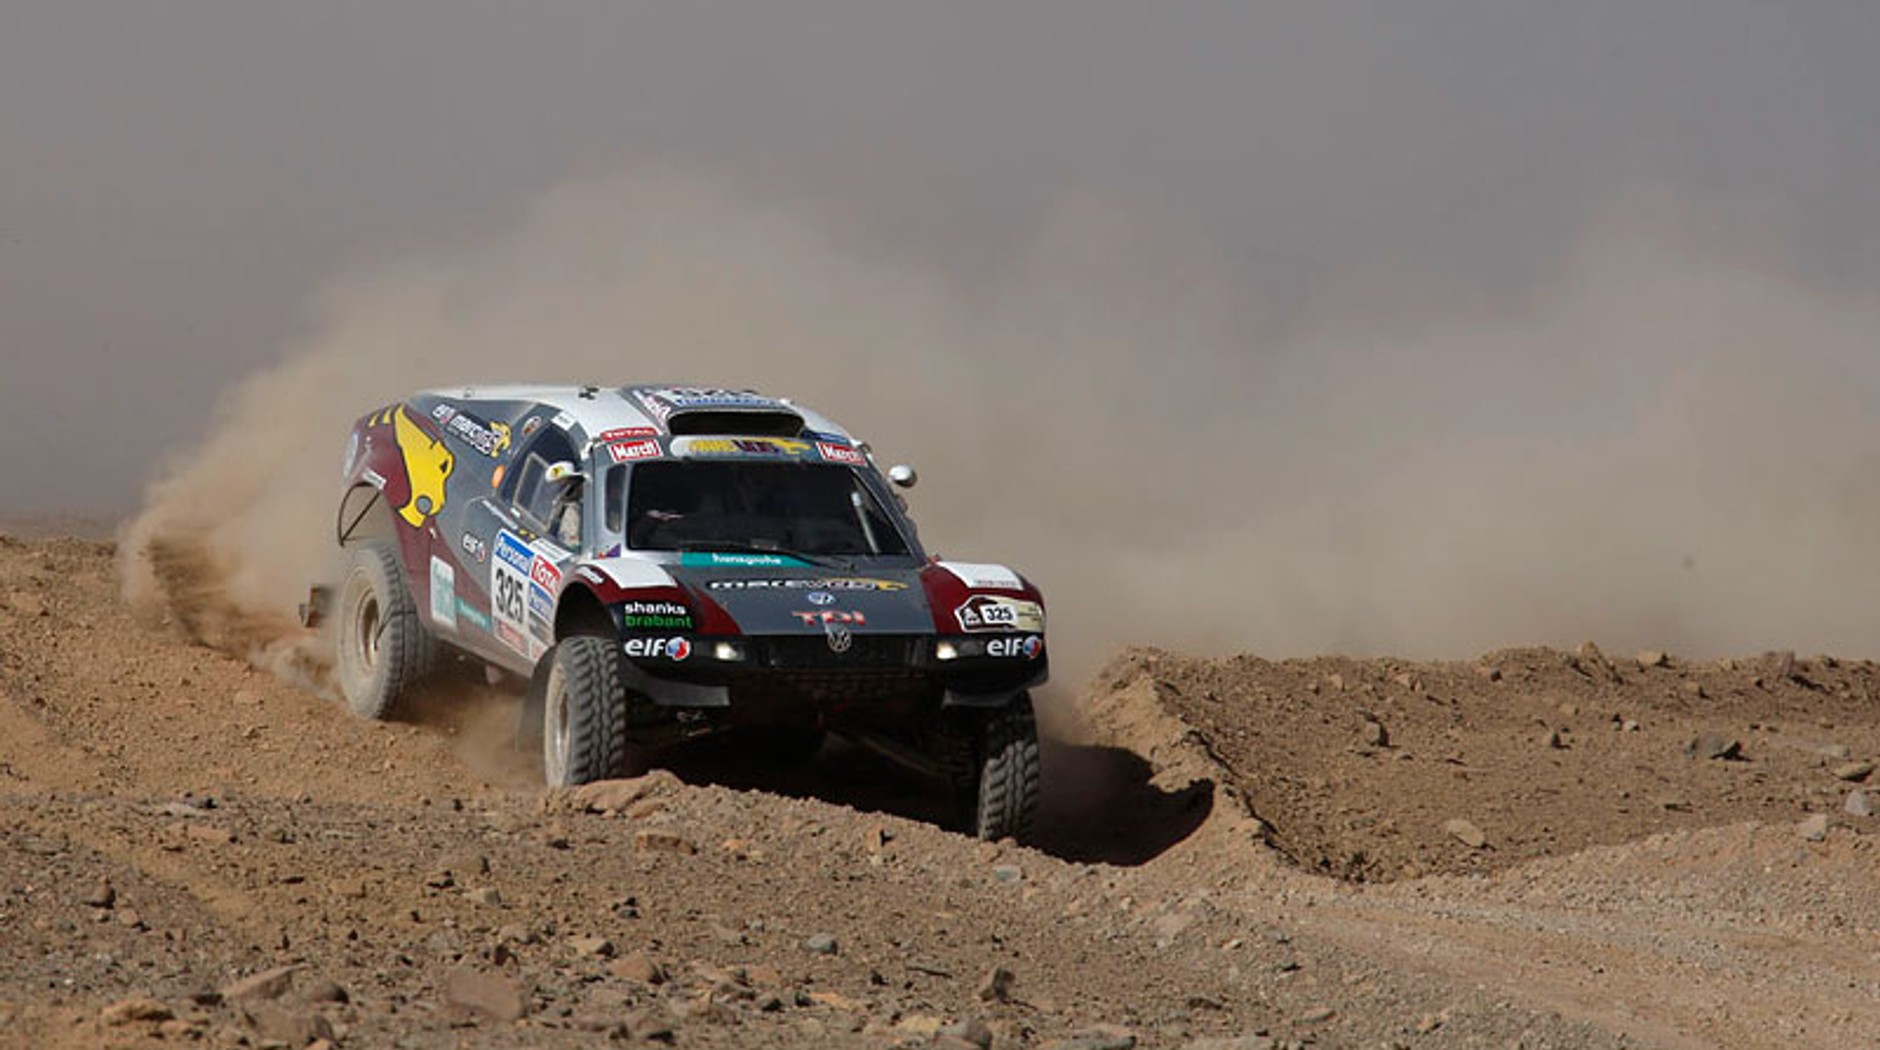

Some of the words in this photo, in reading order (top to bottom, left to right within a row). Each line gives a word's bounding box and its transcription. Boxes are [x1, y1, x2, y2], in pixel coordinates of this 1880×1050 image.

[496, 567, 523, 624] 325
[624, 601, 686, 615] shanks
[985, 606, 1013, 621] 325
[625, 614, 692, 628] brabant
[791, 610, 866, 626] TDI
[624, 639, 667, 657] elf
[986, 638, 1024, 656] elf
